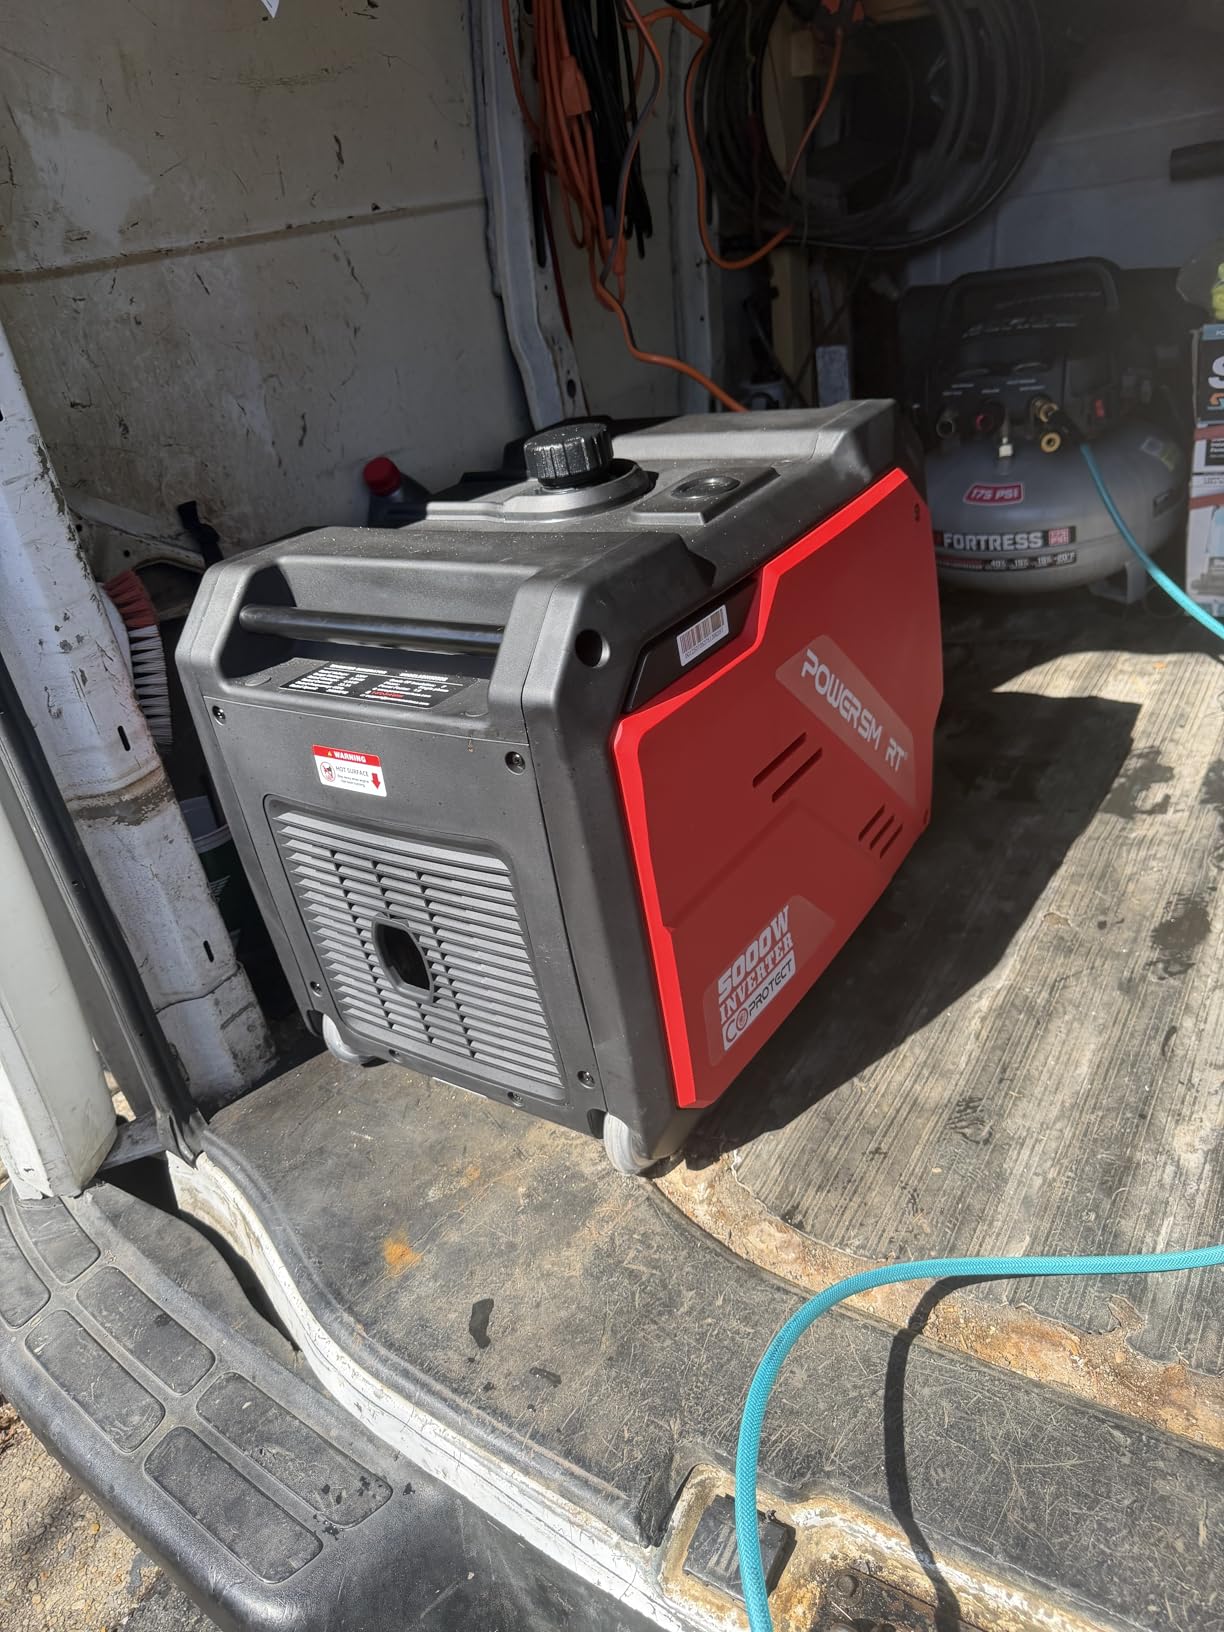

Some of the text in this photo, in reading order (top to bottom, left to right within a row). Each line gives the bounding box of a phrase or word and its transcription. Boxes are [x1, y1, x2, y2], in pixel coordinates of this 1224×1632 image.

[971, 487, 1019, 500] 175 PSI
[943, 531, 1043, 551] FORTRESS
[334, 750, 367, 763] WARNING
[718, 904, 789, 1005] 5000W
[720, 932, 794, 1024] INVERTER
